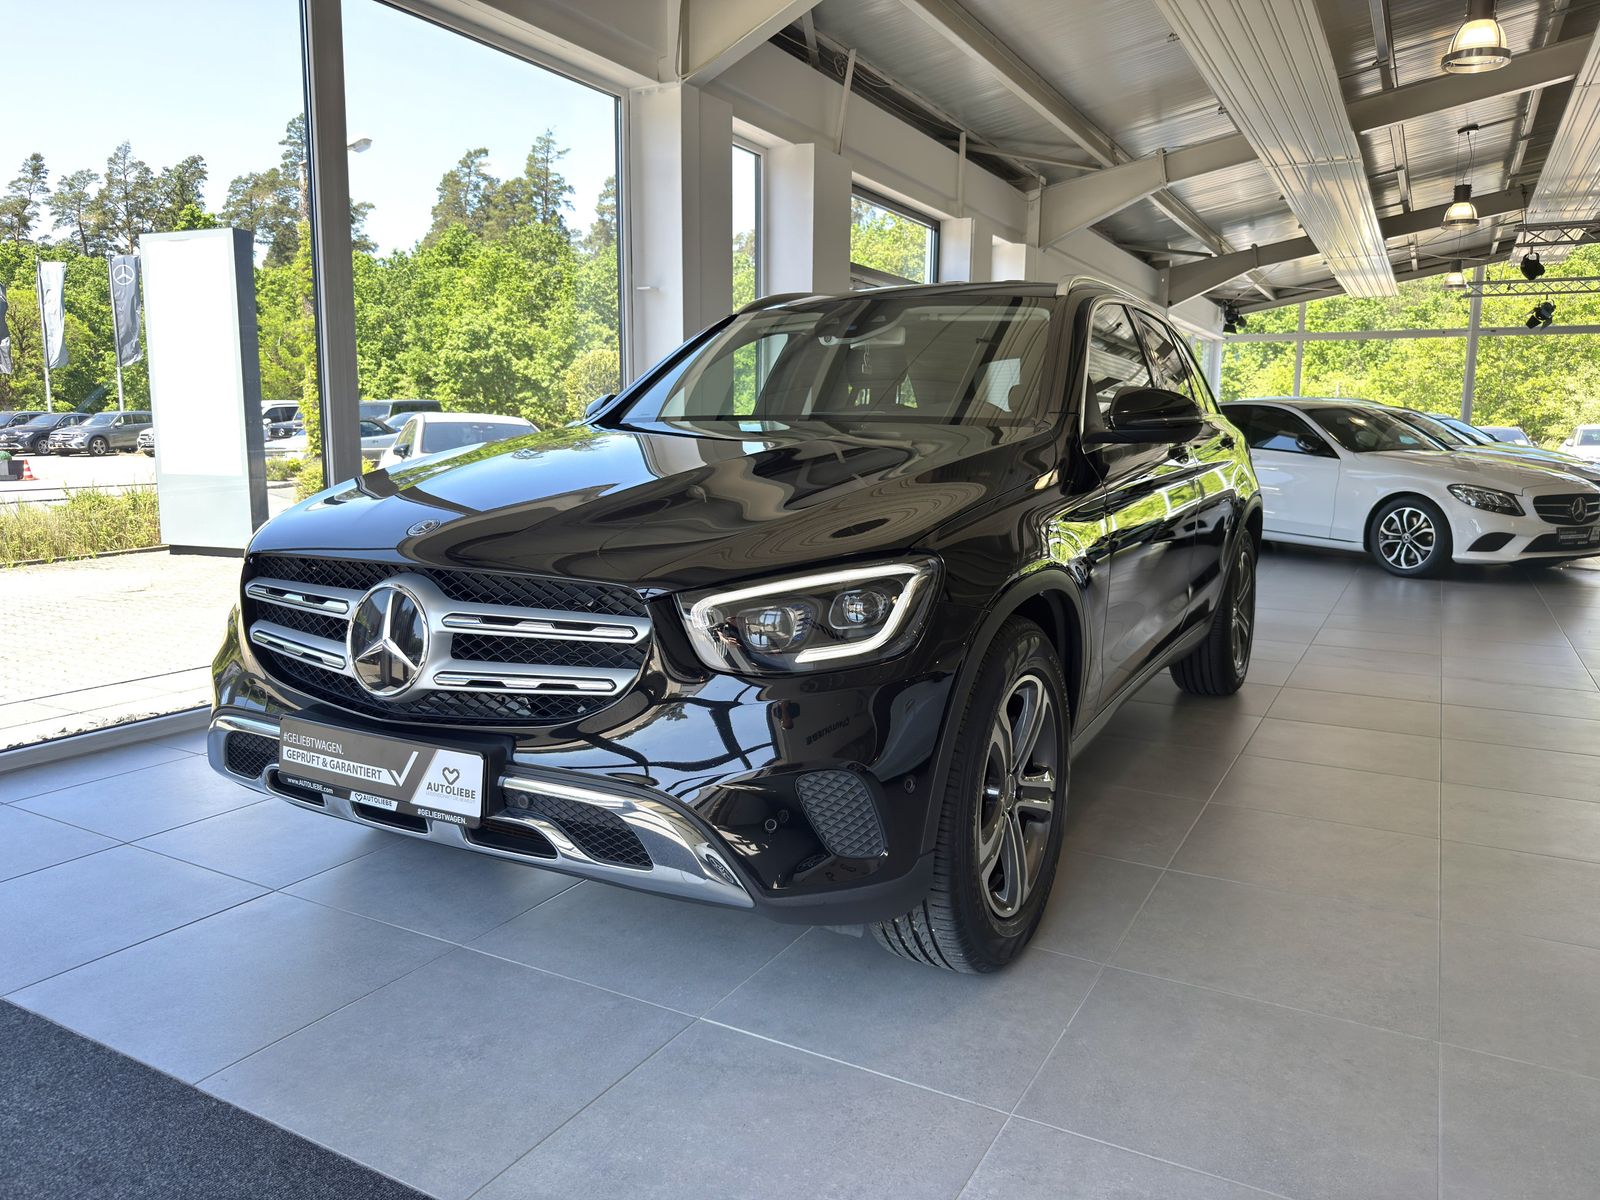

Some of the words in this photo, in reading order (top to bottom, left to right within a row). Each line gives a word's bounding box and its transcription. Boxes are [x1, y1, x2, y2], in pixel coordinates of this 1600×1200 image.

[286, 749, 320, 767] GEPRÜFT
[321, 757, 328, 768] &
[329, 760, 383, 781] GARANTIERT
[287, 778, 334, 794] www.AUTOLIEBE.com
[426, 782, 476, 800] AUTOLIEBE
[363, 794, 393, 807] AUTOLIEBE
